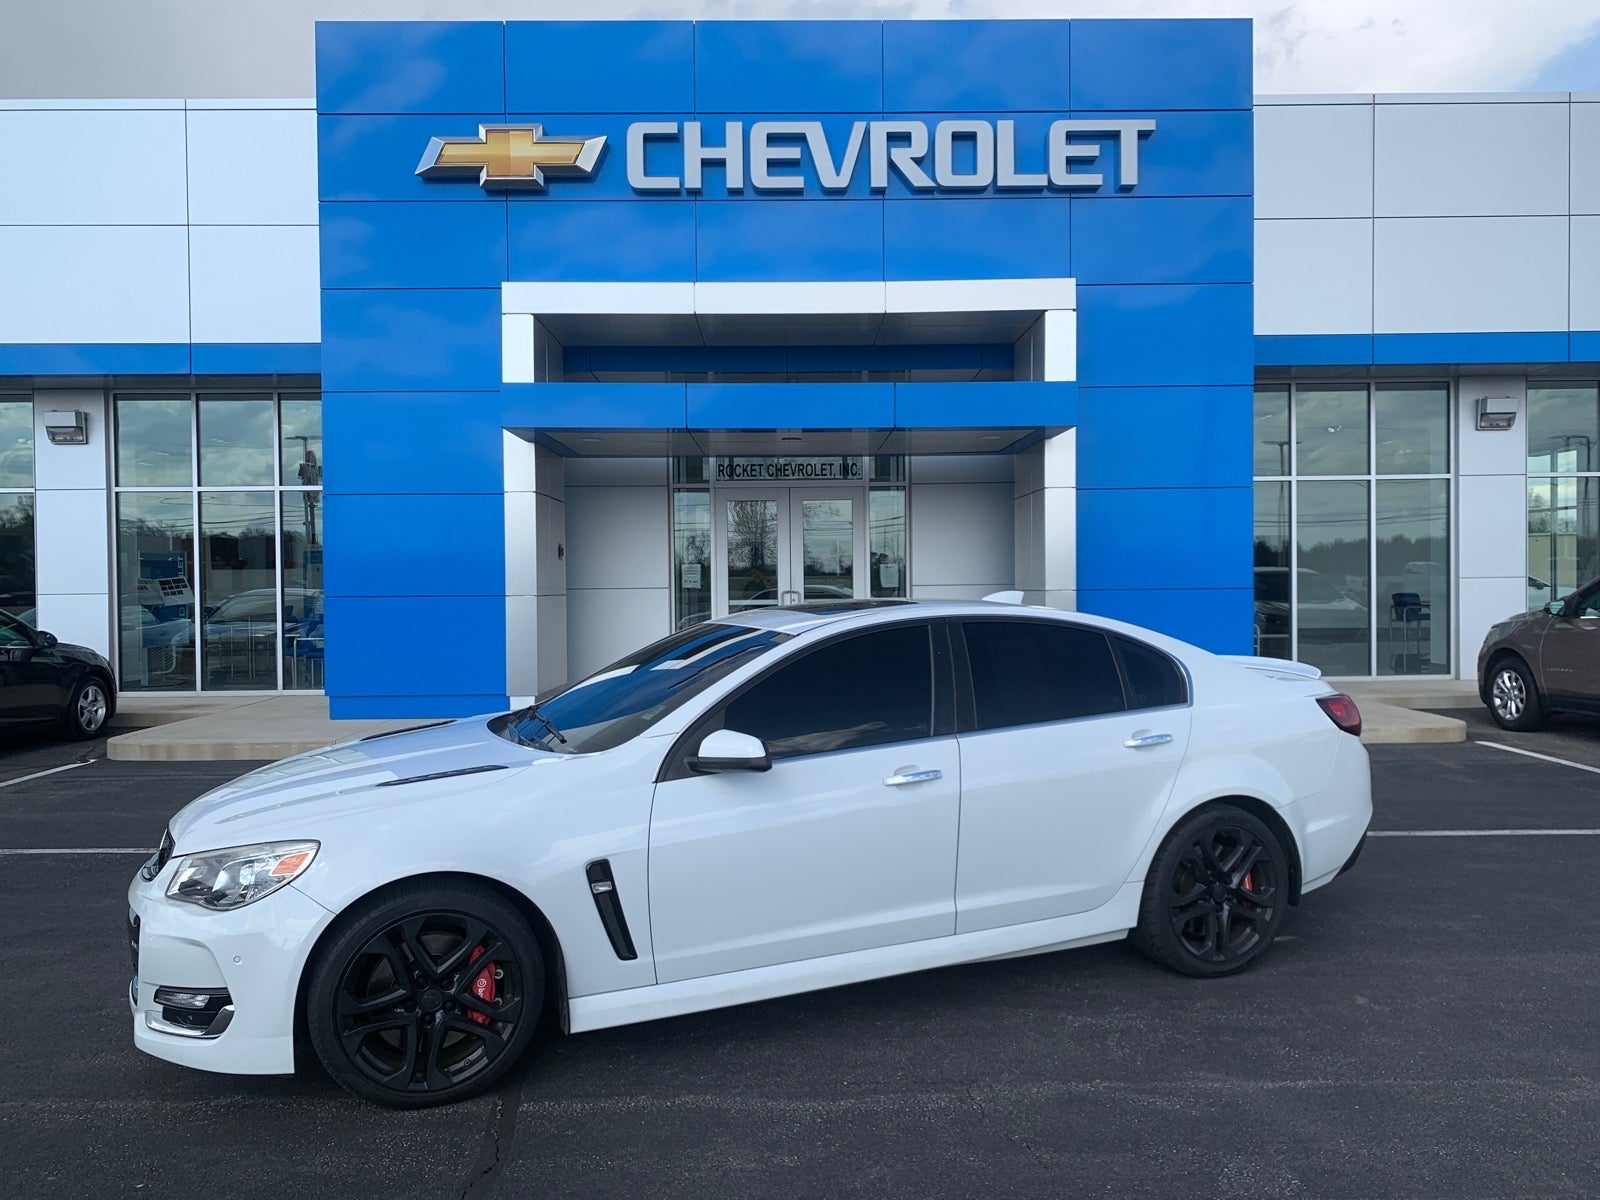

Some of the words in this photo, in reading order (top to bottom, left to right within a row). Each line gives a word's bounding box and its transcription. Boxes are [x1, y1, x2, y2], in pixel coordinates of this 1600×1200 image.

[626, 119, 1156, 191] CHEVROLET
[717, 463, 765, 478] ROCKET
[839, 462, 861, 477] INC.
